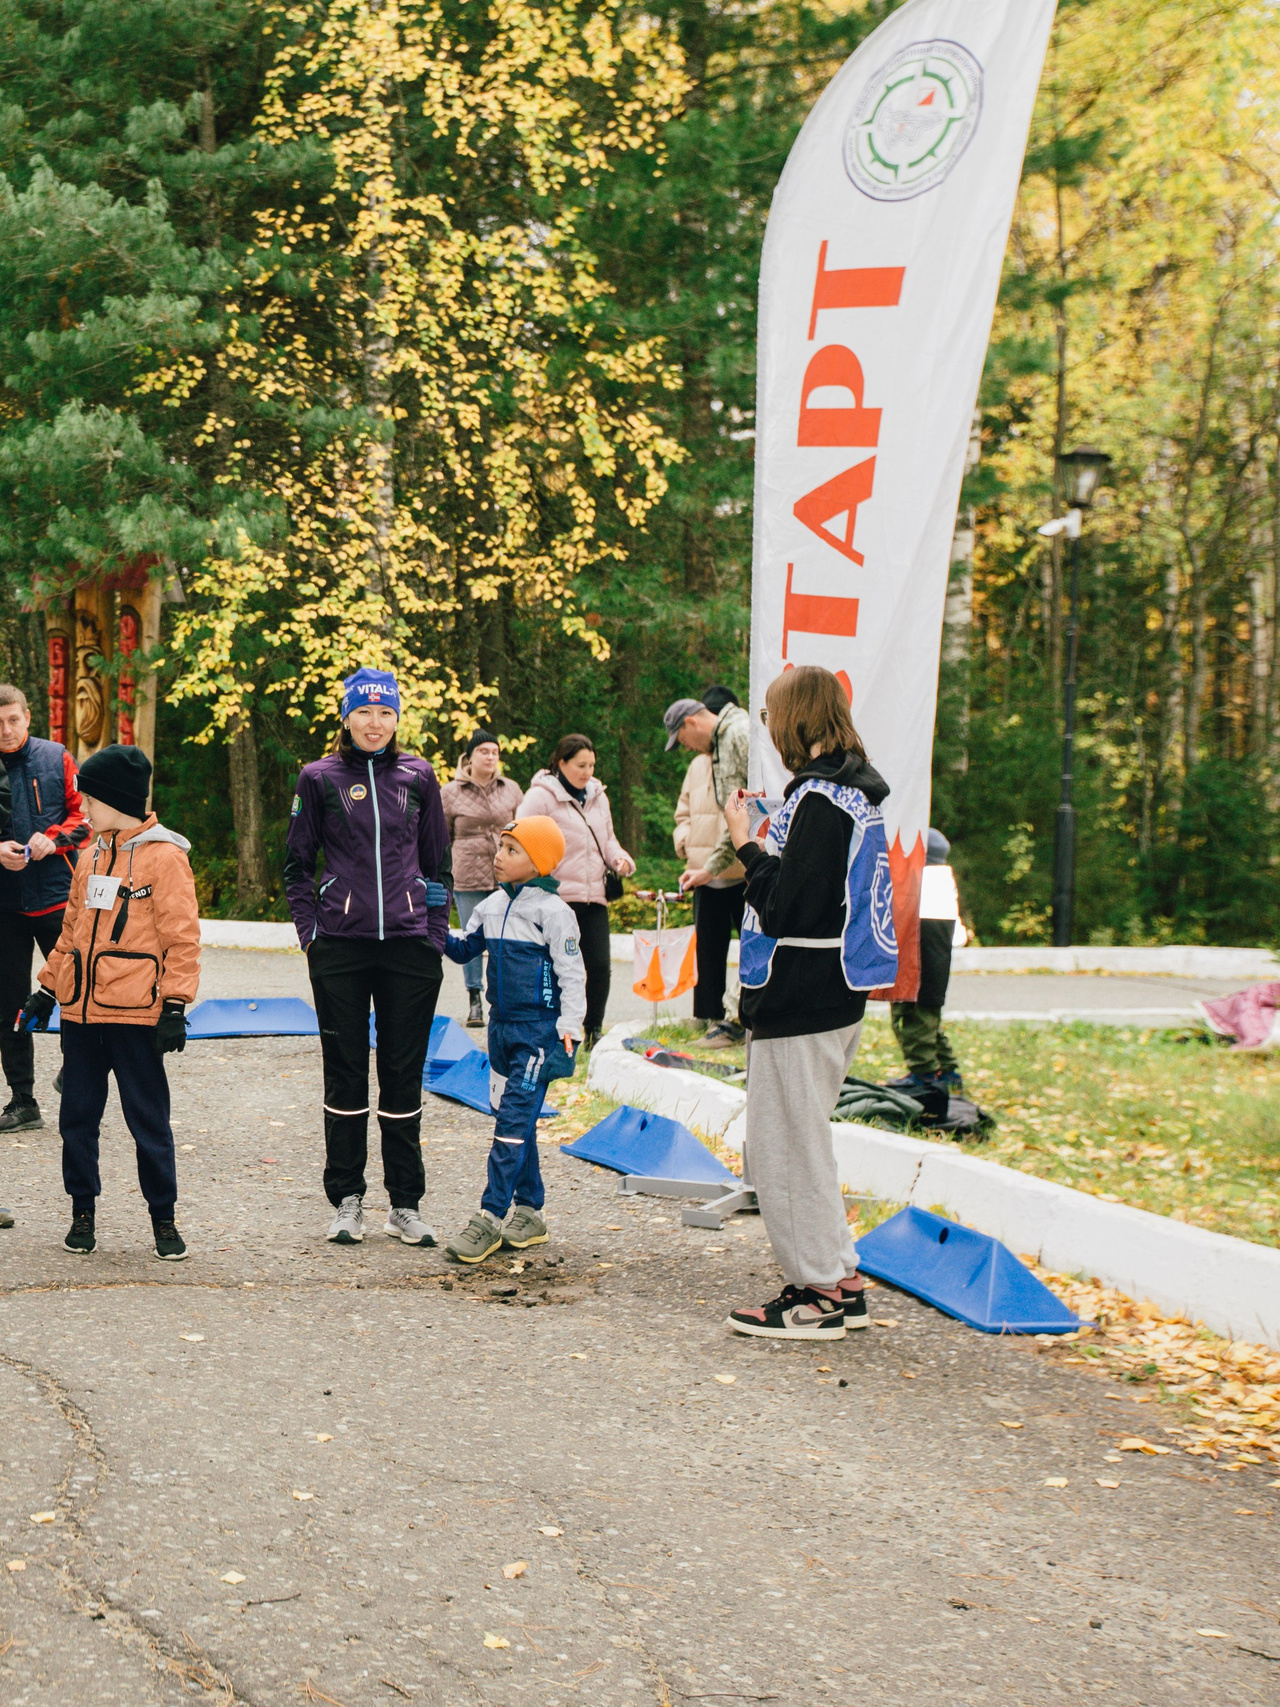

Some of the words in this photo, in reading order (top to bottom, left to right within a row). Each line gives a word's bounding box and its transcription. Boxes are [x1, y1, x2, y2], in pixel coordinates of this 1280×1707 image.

[782, 240, 905, 708] ТАРТ
[357, 684, 390, 695] VITAL
[129, 889, 147, 899] END
